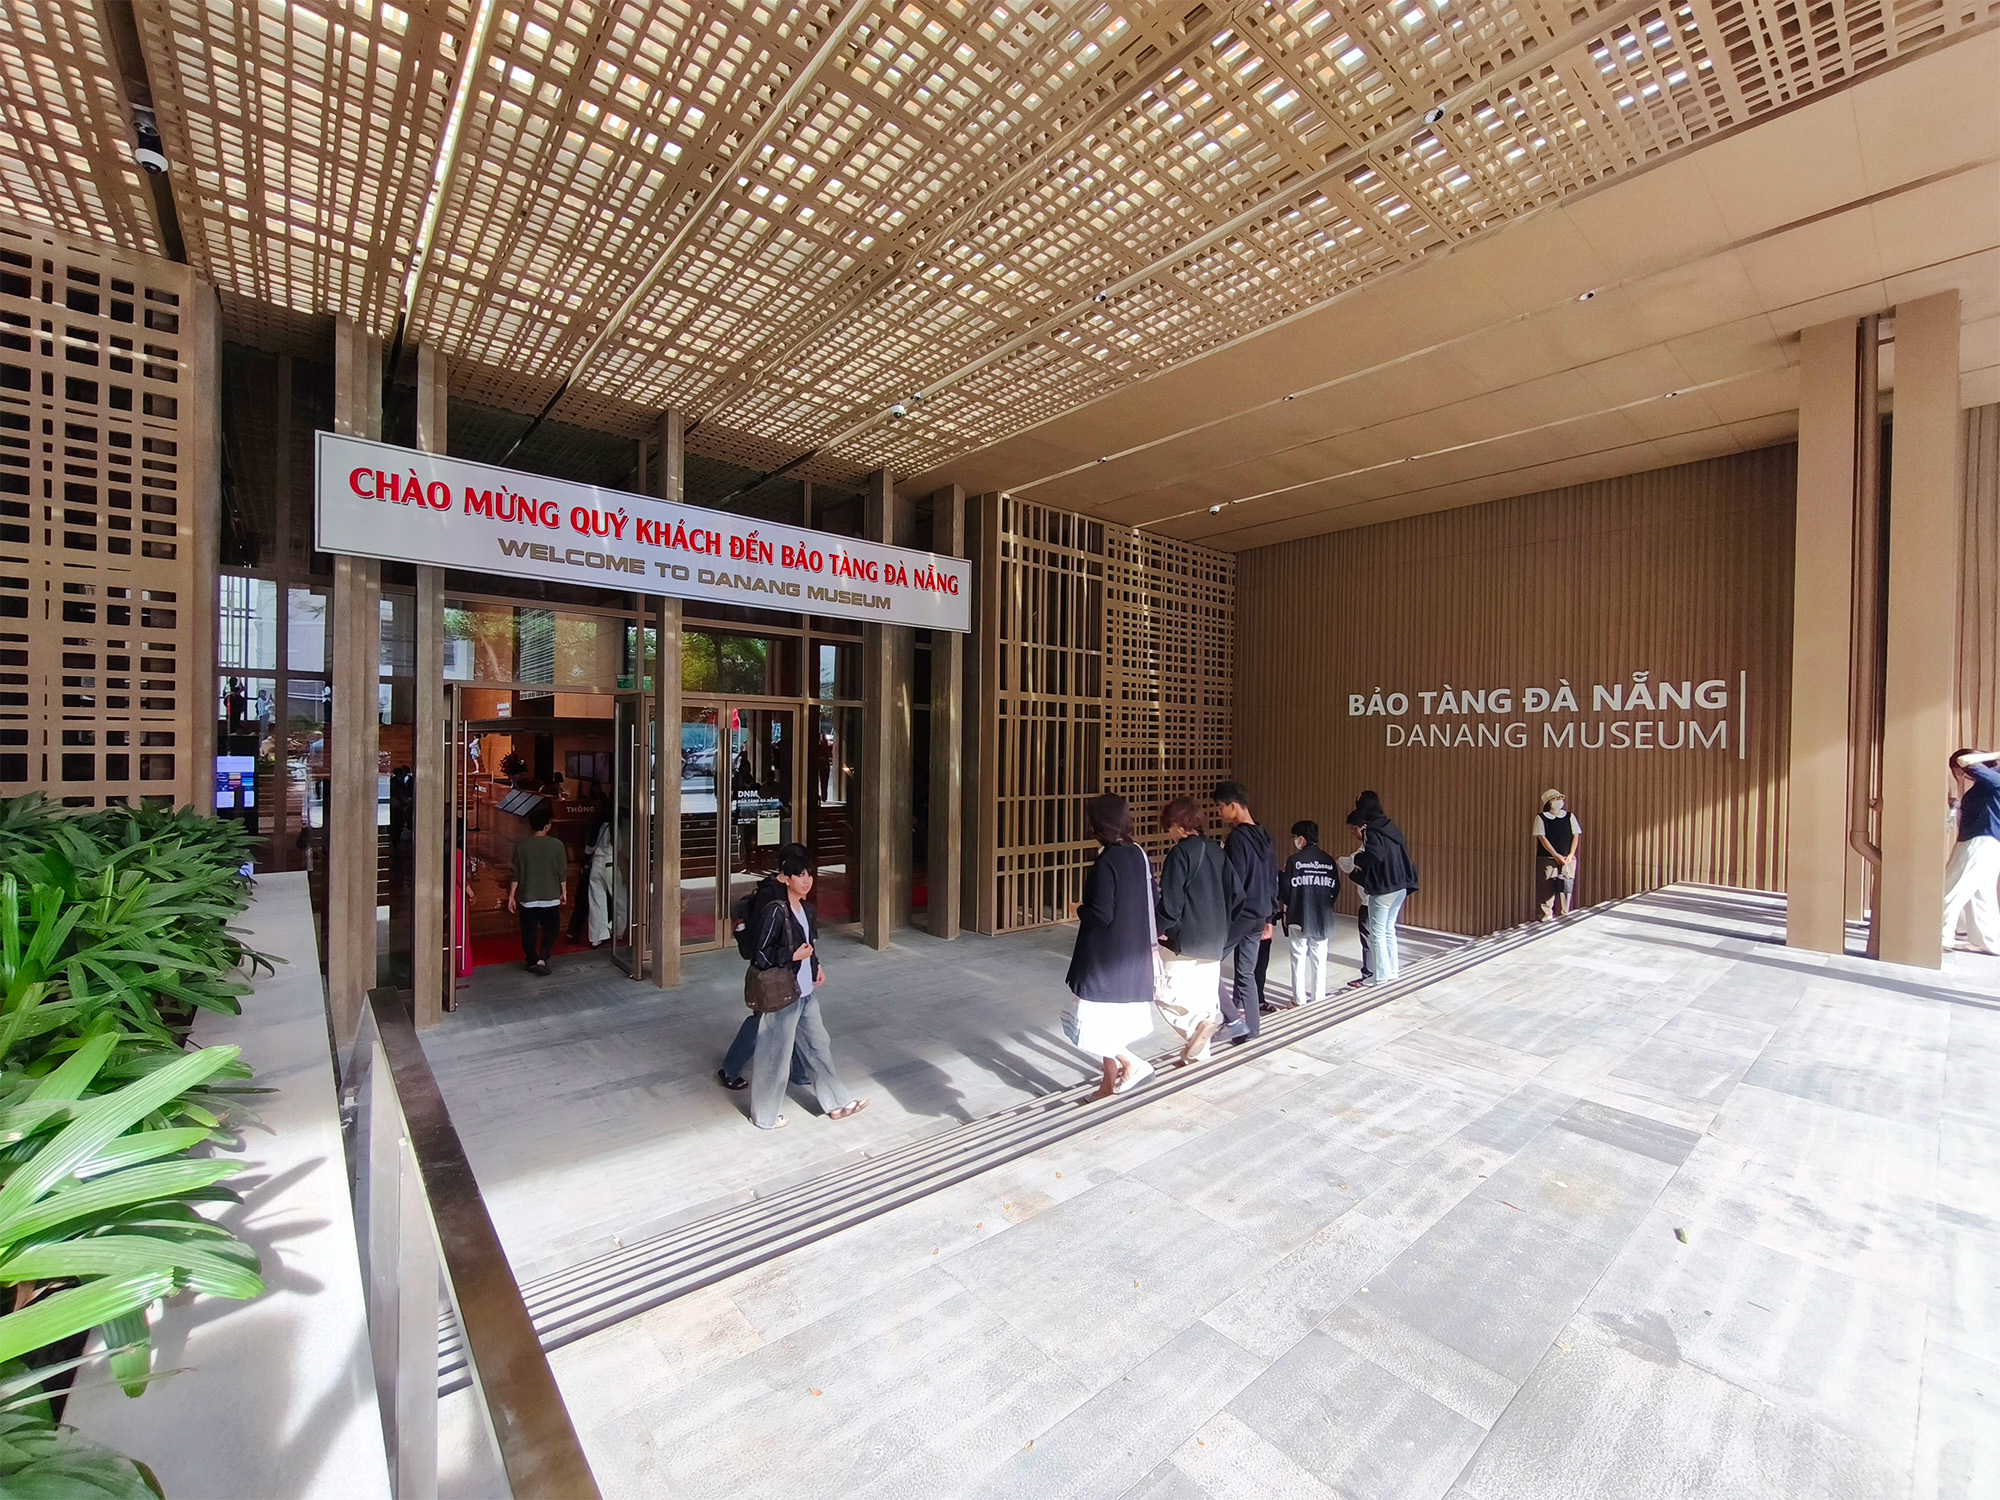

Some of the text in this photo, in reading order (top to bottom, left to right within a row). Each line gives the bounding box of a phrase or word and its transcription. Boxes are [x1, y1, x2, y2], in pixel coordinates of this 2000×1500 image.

[349, 468, 959, 596] CHÀO MỪNG QUÝ KHÁCH ĐẾN BẢO TÀNG ĐÀ NẴNG
[497, 538, 891, 610] WELCOME TO DANANG MUSEUM
[1348, 670, 1728, 716] BẢO TÀNG ĐÀ NẴNG
[1386, 720, 1727, 750] DANANG MUSEUM
[566, 804, 596, 813] THÔNG
[737, 790, 758, 798] DNM
